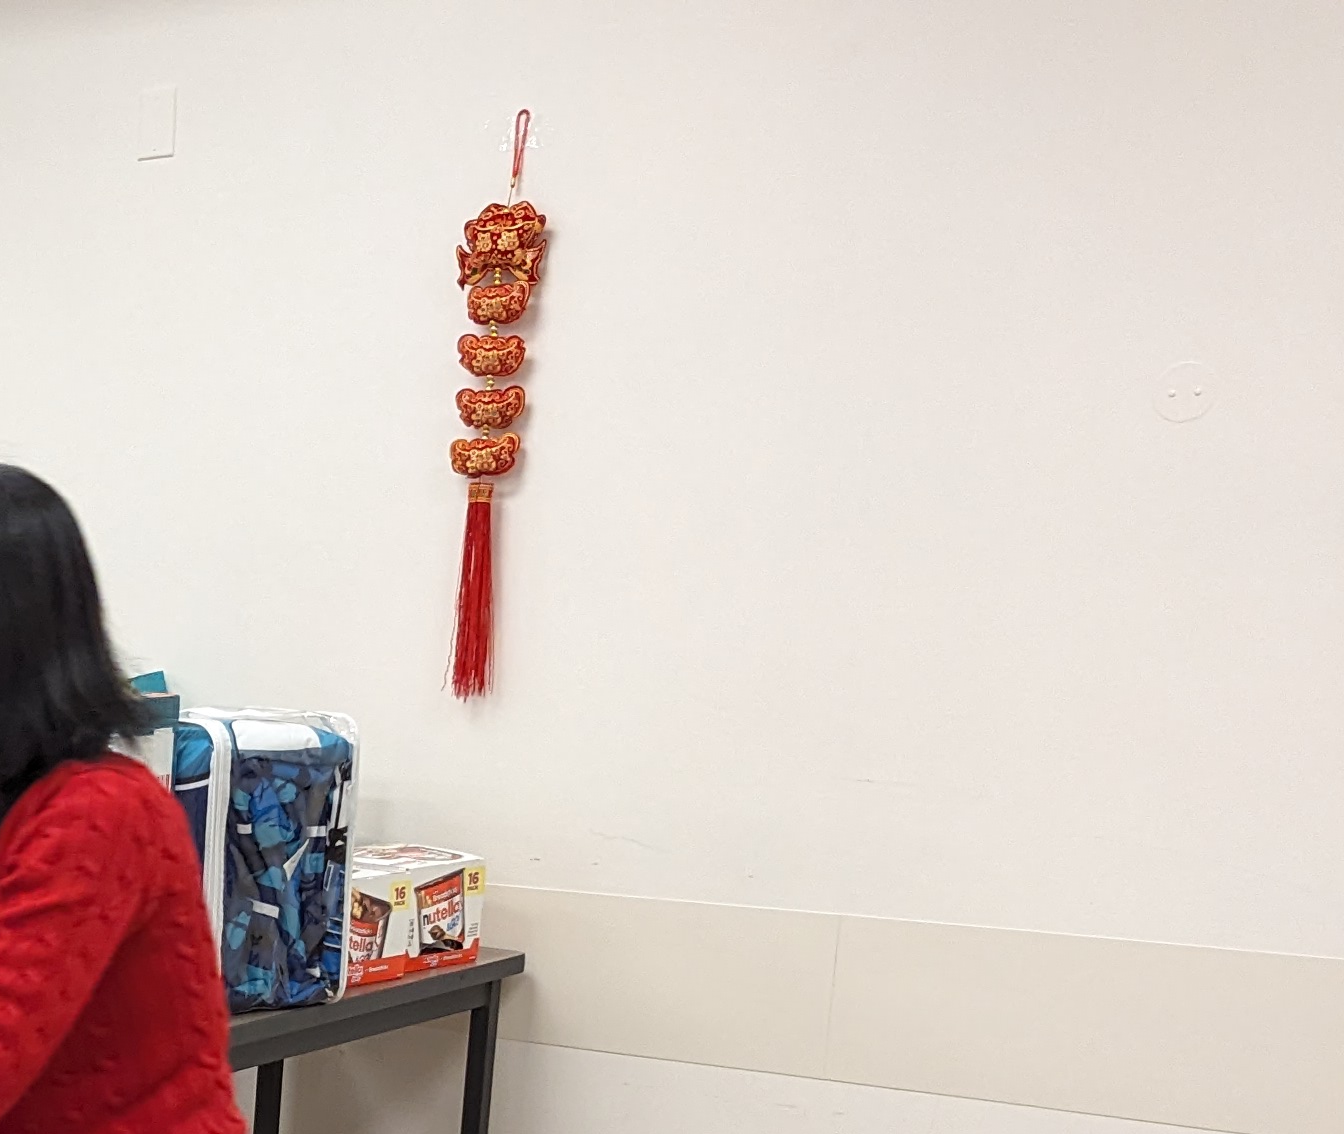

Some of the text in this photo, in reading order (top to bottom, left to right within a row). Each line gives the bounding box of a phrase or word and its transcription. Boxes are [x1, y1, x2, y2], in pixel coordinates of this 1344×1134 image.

[468, 871, 480, 885] 16
[394, 886, 407, 900] 16
[423, 899, 461, 927] nutella
[348, 935, 373, 953] tella
